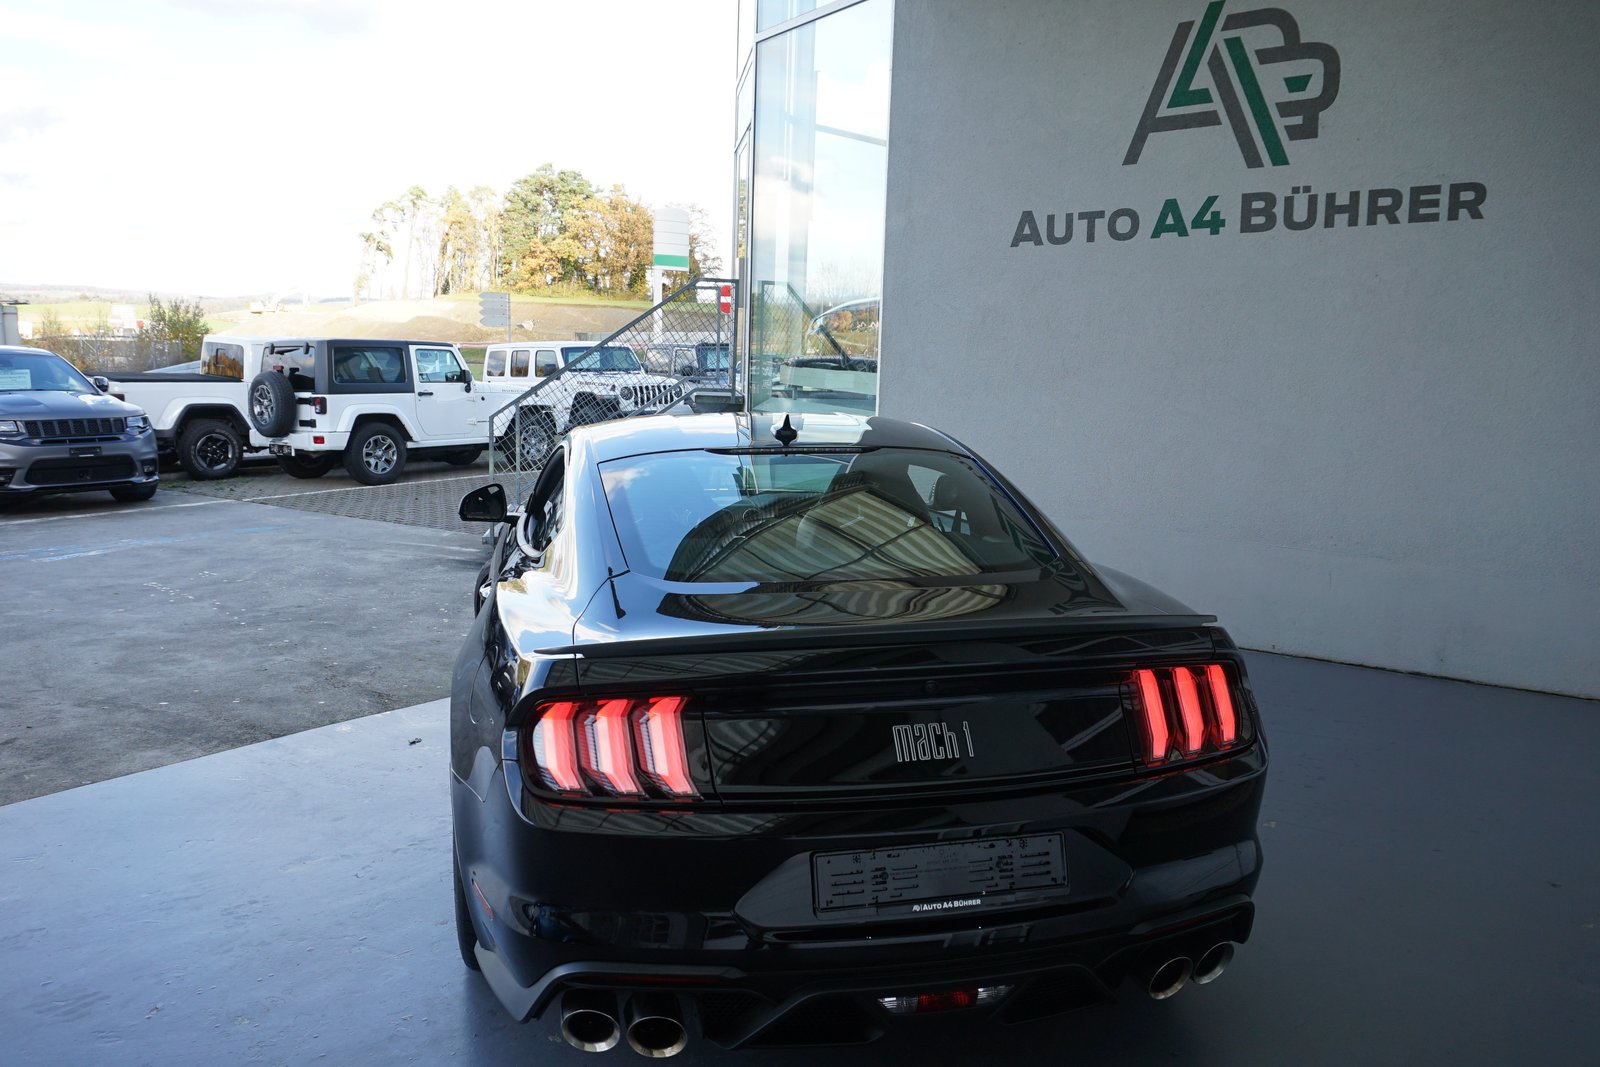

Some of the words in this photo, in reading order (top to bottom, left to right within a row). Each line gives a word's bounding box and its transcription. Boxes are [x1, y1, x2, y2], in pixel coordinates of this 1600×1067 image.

[1010, 207, 1140, 248] AUTO
[1150, 195, 1226, 239] A4
[1240, 181, 1488, 234] BÜHRER
[962, 721, 975, 758] 1
[922, 903, 942, 911] AUTO
[943, 901, 953, 909] A4
